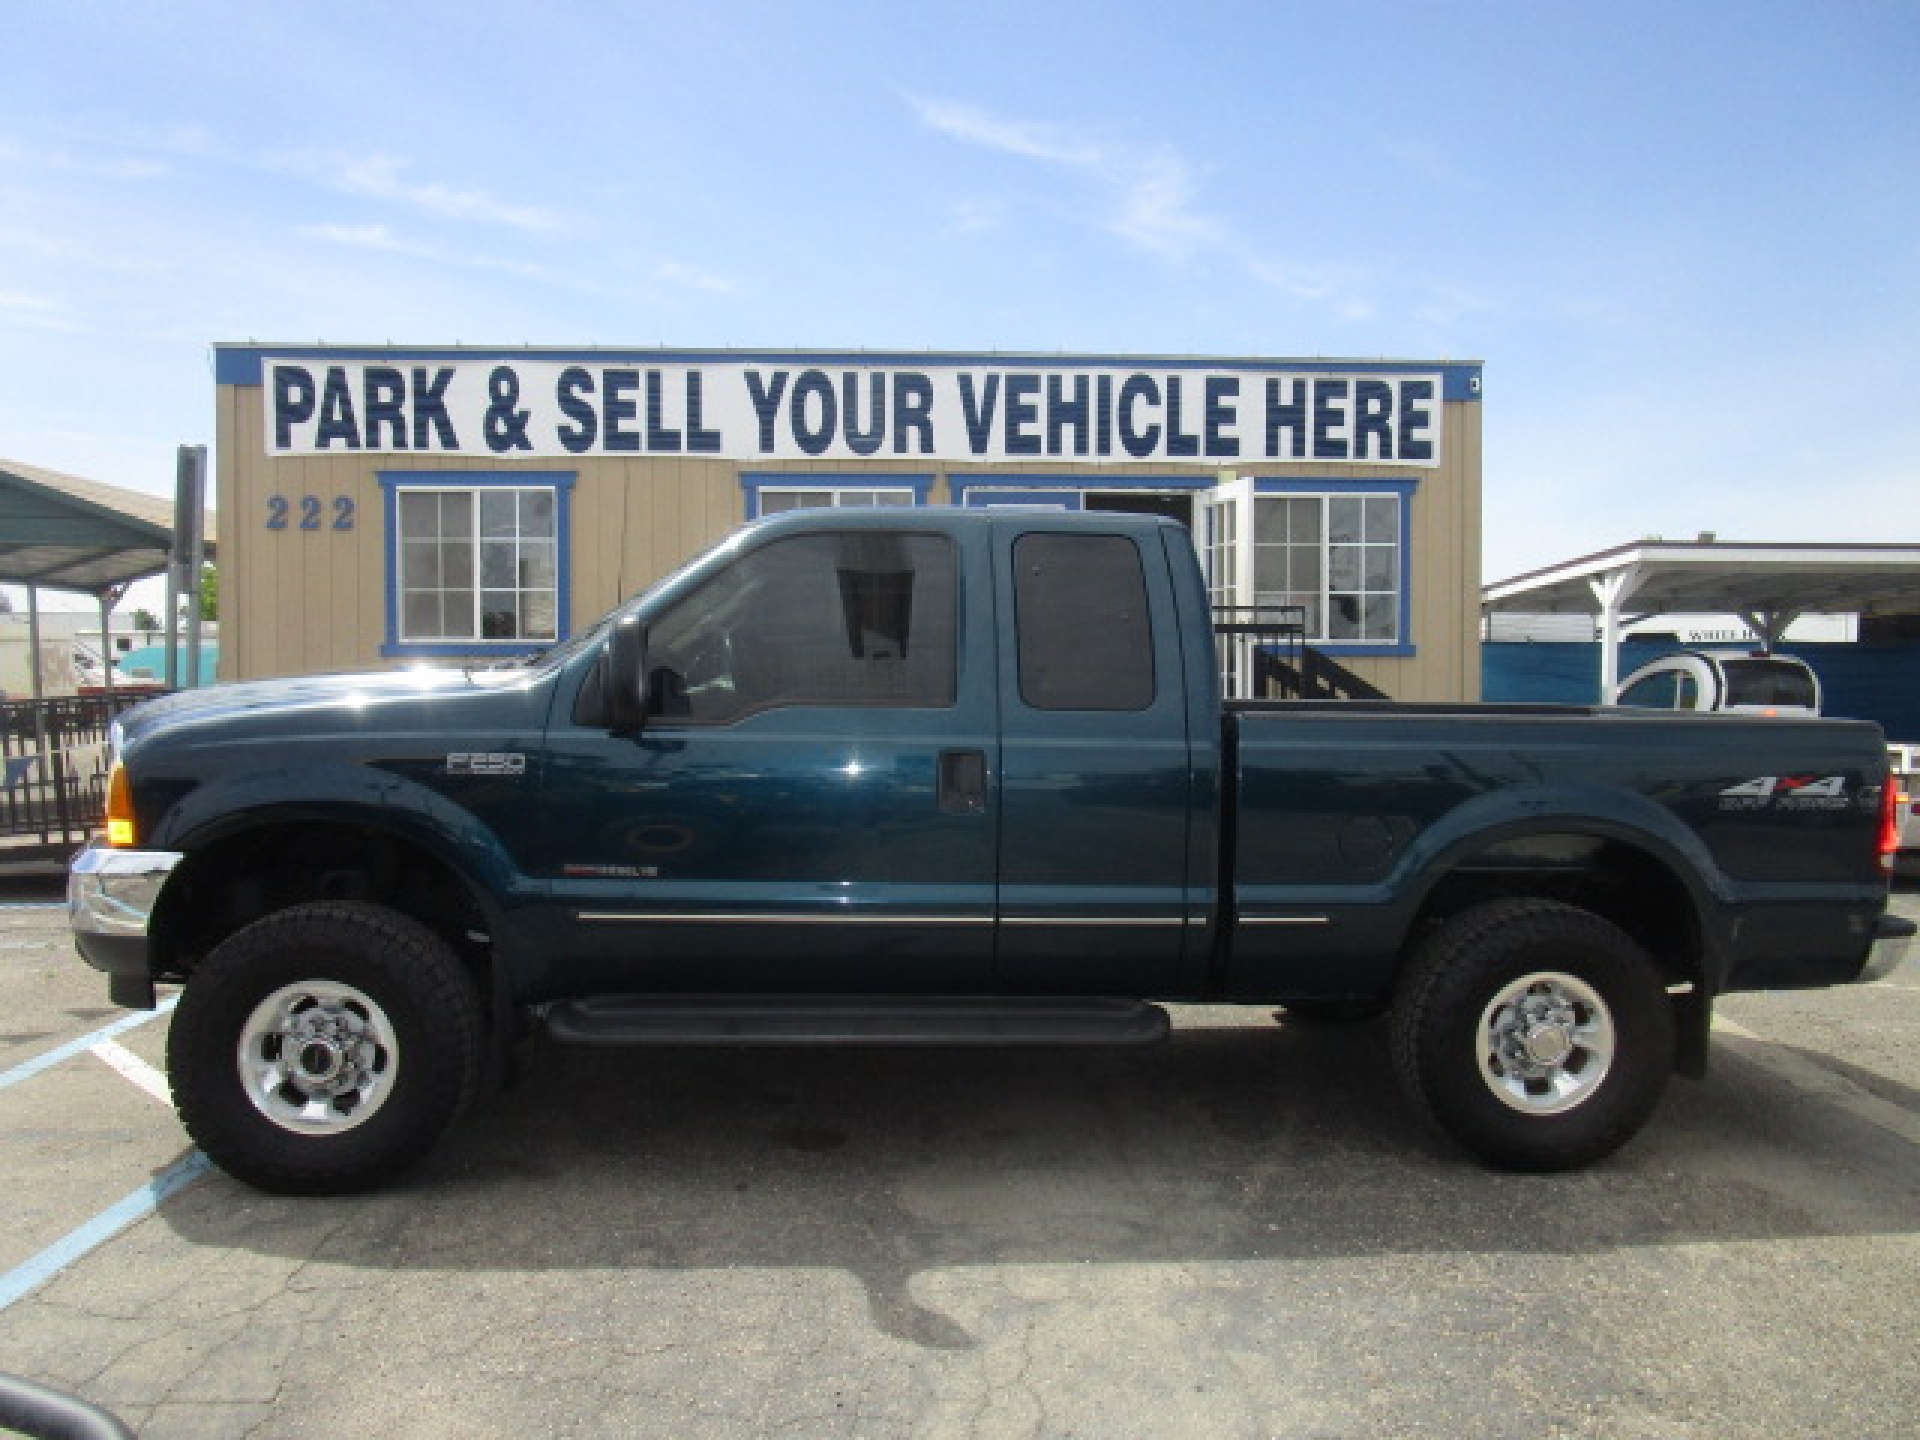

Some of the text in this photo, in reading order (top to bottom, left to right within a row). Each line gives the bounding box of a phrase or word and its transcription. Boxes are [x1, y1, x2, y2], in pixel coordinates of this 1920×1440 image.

[273, 366, 1434, 459] PARK & SELL YOUR VEHICLE HERE
[265, 496, 355, 529] 222
